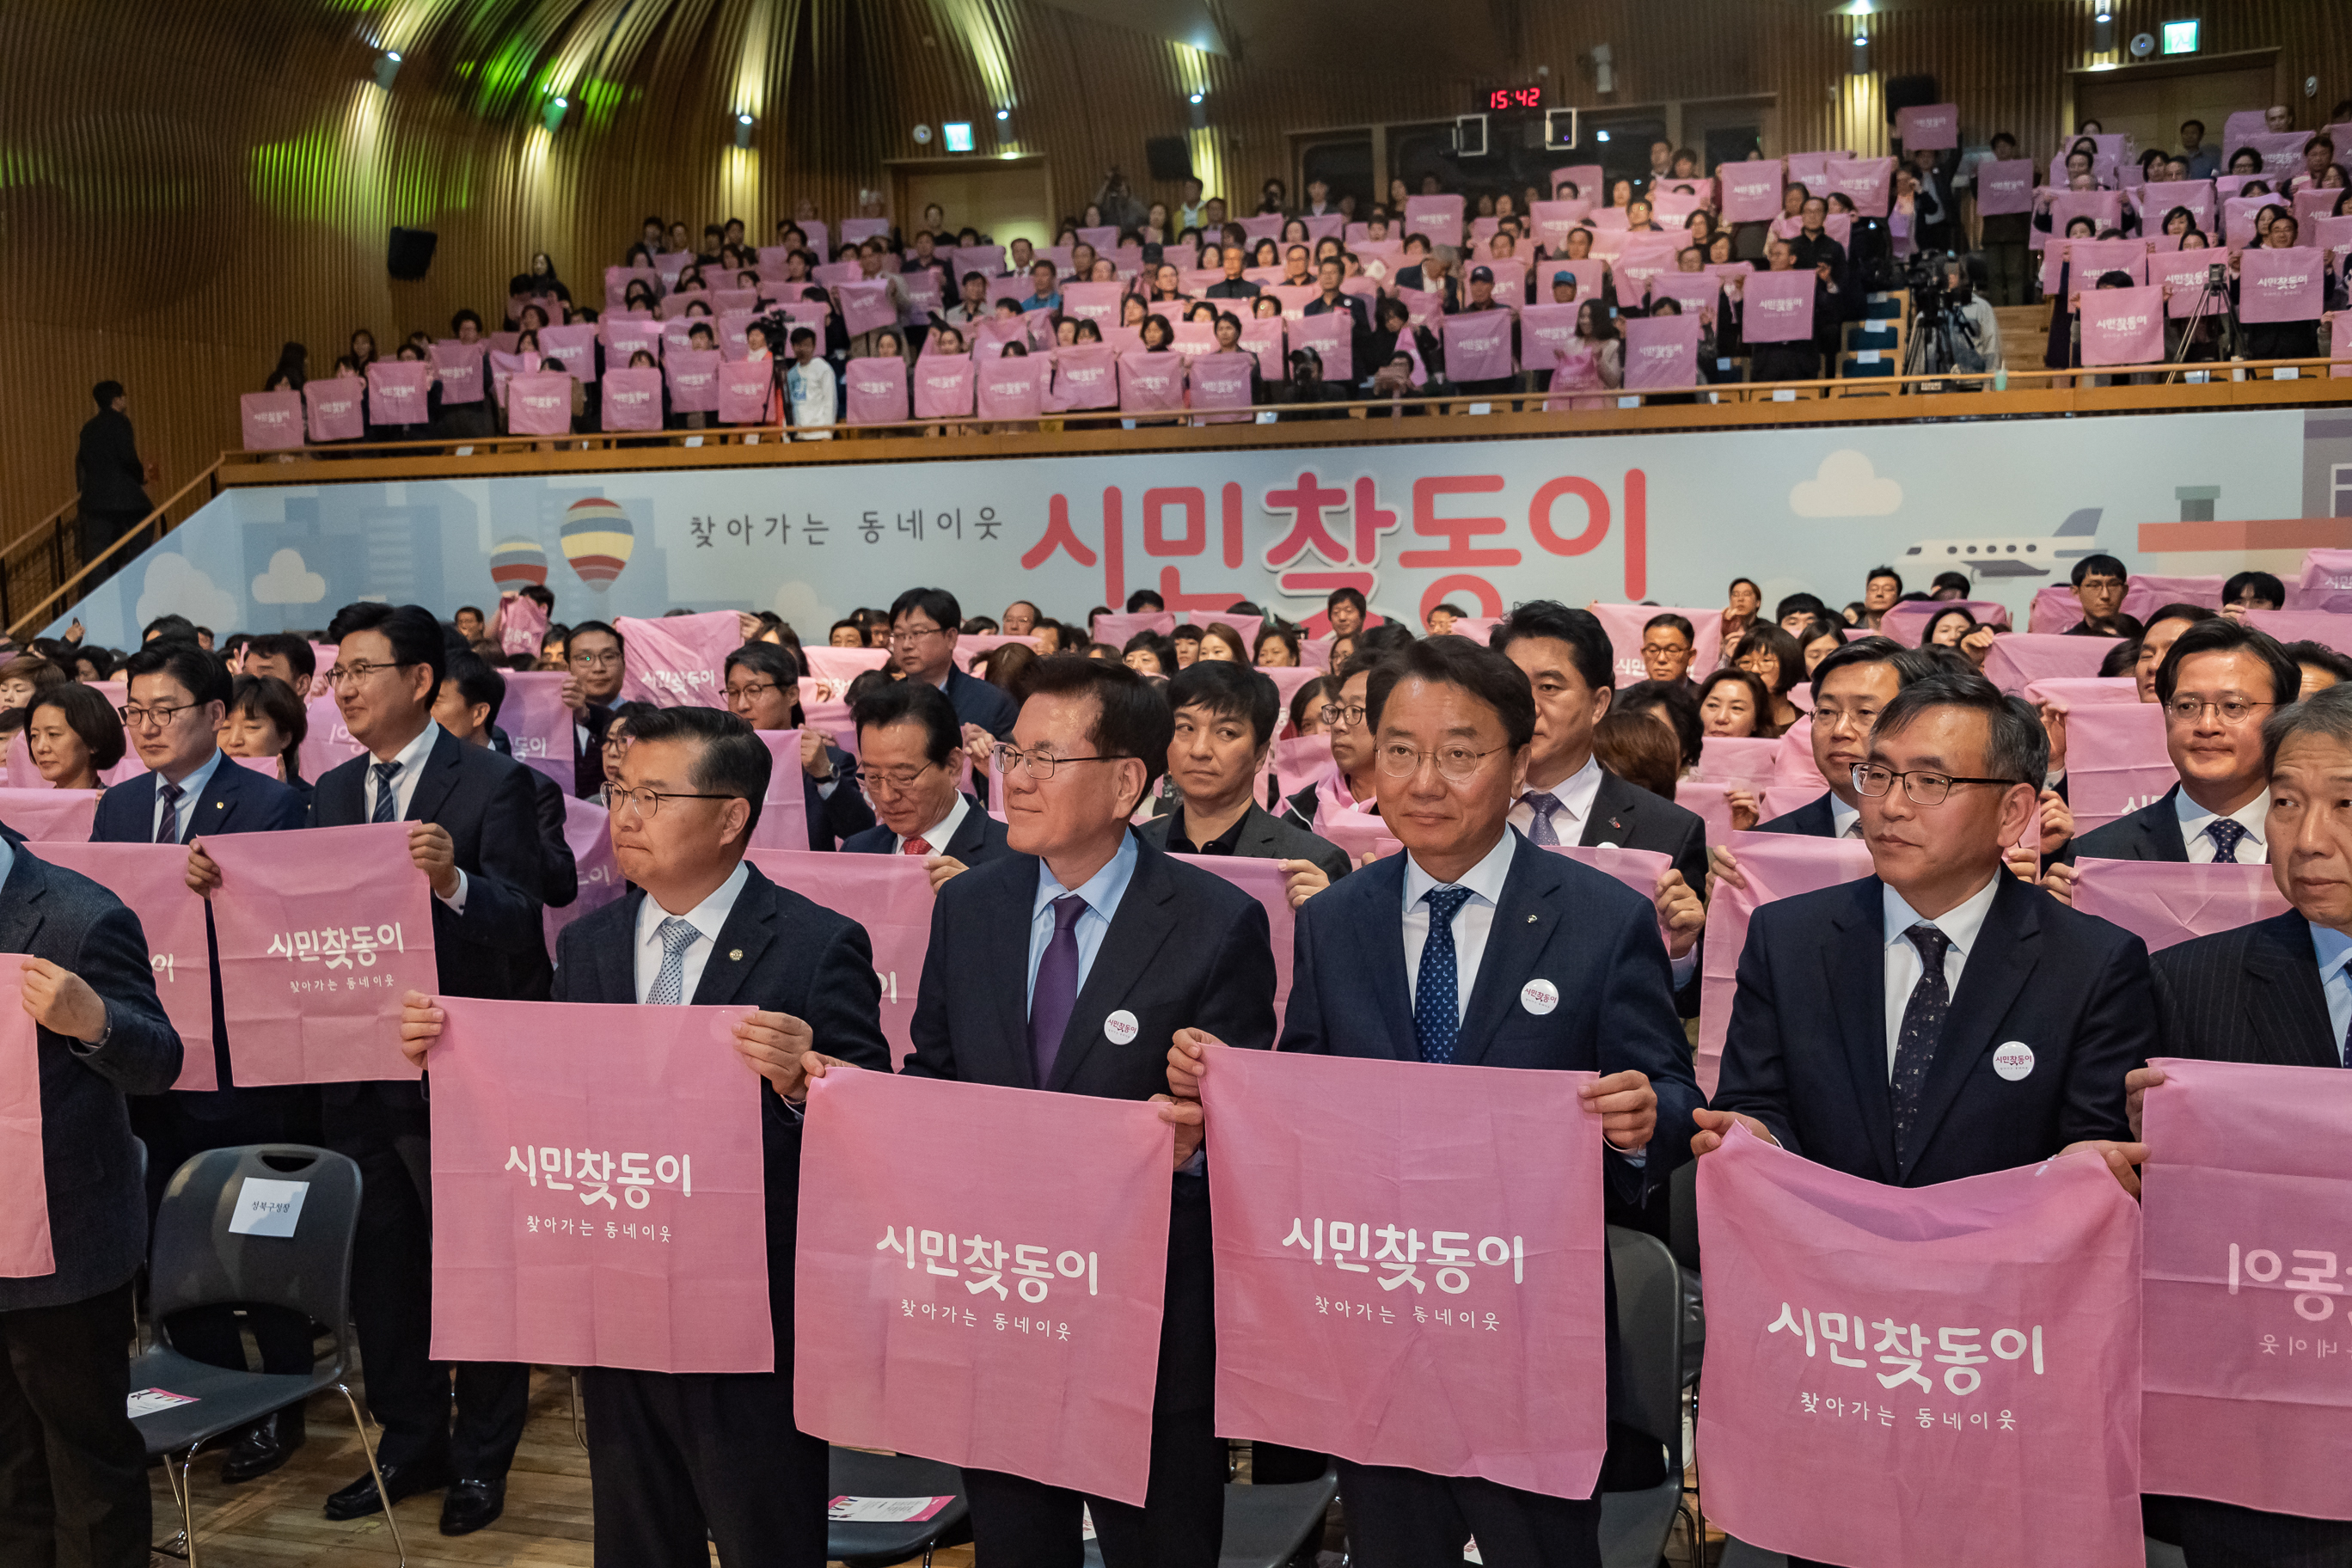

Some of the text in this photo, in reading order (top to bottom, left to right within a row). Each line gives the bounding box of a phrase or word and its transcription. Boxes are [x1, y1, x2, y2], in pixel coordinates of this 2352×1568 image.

[1491, 88, 1540, 109] 15:42
[690, 468, 1647, 639] 찾아가는 동네이웃 시민찾동이
[267, 922, 404, 970] 시민찾동이
[290, 974, 395, 994] 찾아가는 동네이웃
[1995, 1055, 2032, 1066] 시민찾동이
[505, 1145, 692, 1210] 시민찾동이
[526, 1216, 671, 1243] 찾아가는 동네이웃
[877, 1225, 1098, 1302] 시민찾동이
[1283, 1218, 1523, 1294] 시민찾동이
[901, 1299, 1071, 1341] 찾아가는 동네이웃
[1315, 1295, 1500, 1331] 찾아가는 동네이웃
[1767, 1302, 2044, 1395] 시민찾동이
[1800, 1392, 2017, 1430] 찾아가는 동네이웃
